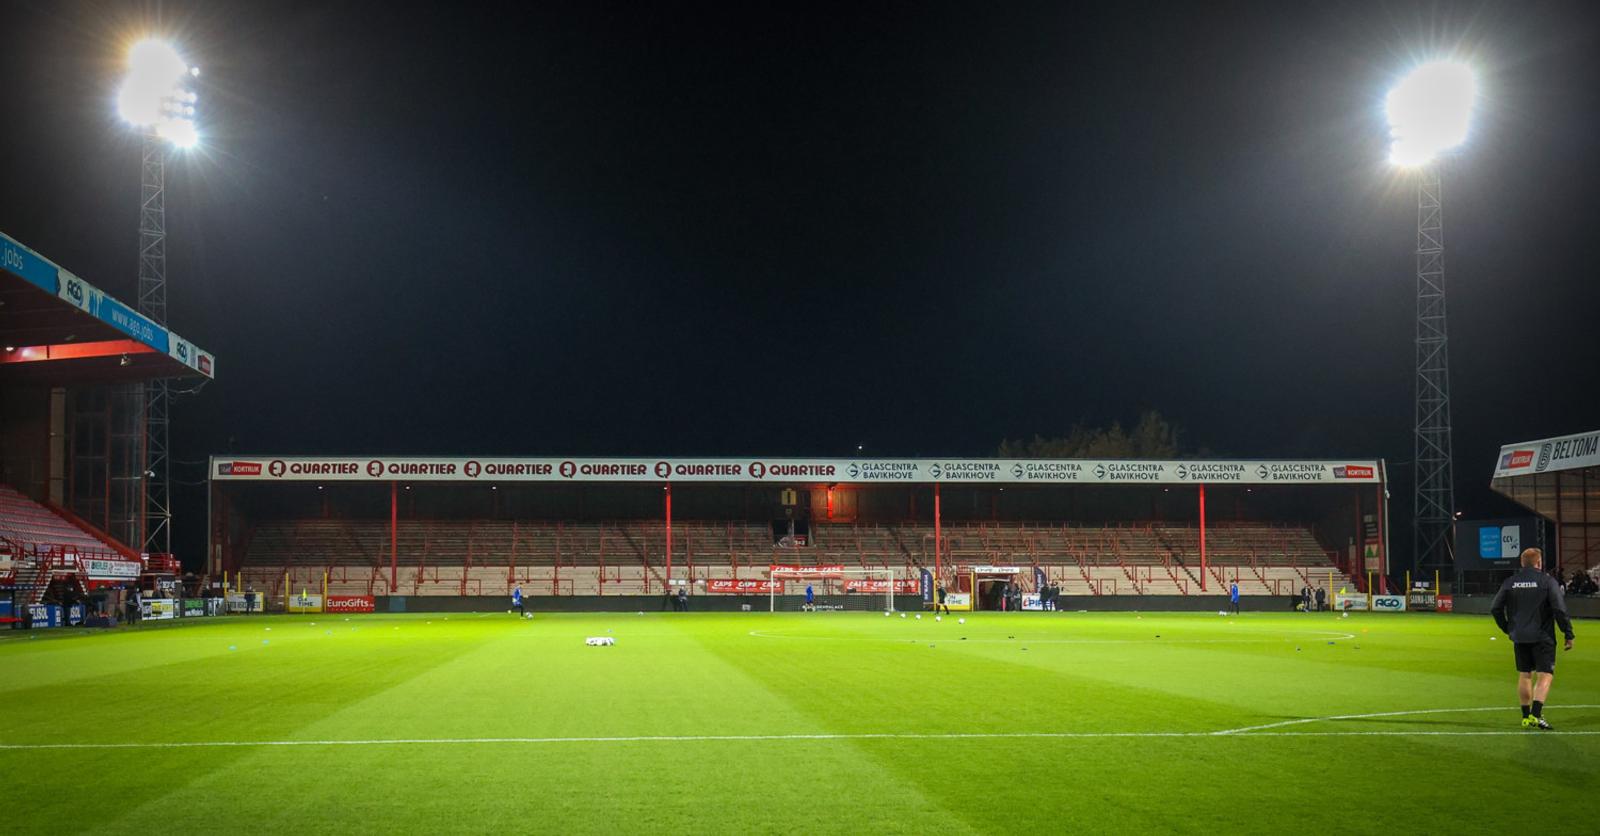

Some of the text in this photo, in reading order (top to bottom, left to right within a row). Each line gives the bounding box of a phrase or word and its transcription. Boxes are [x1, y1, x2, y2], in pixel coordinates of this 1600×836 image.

[1552, 436, 1599, 461] BELTONA
[290, 463, 359, 475] QUARTIER
[388, 463, 456, 475] QUARTIER
[485, 463, 553, 475] QUARTIER
[580, 463, 647, 475] QUARTIER
[675, 463, 742, 475] QUARTIER
[769, 463, 836, 475] QUARTIER
[862, 463, 918, 471] GLASCENTRA
[944, 463, 1000, 471] GLASCENTRA
[1026, 463, 1082, 471] GLASCENTRA
[1108, 464, 1164, 472] GLASCENTRA
[1190, 464, 1245, 472] GLASCENTRA
[1271, 464, 1326, 472] GLASCENTRA
[863, 471, 913, 479] BAVIKHOVE
[946, 471, 995, 479] BAVIKHOVE
[1028, 471, 1077, 479] BAVIKHOVE
[1110, 472, 1159, 480] BAVIKHOVE
[1191, 472, 1240, 480] BAVIKHOVE
[1273, 472, 1322, 480] BAVIKHOVE
[327, 599, 369, 608] EuroGifts
[1375, 598, 1400, 607] AGO
